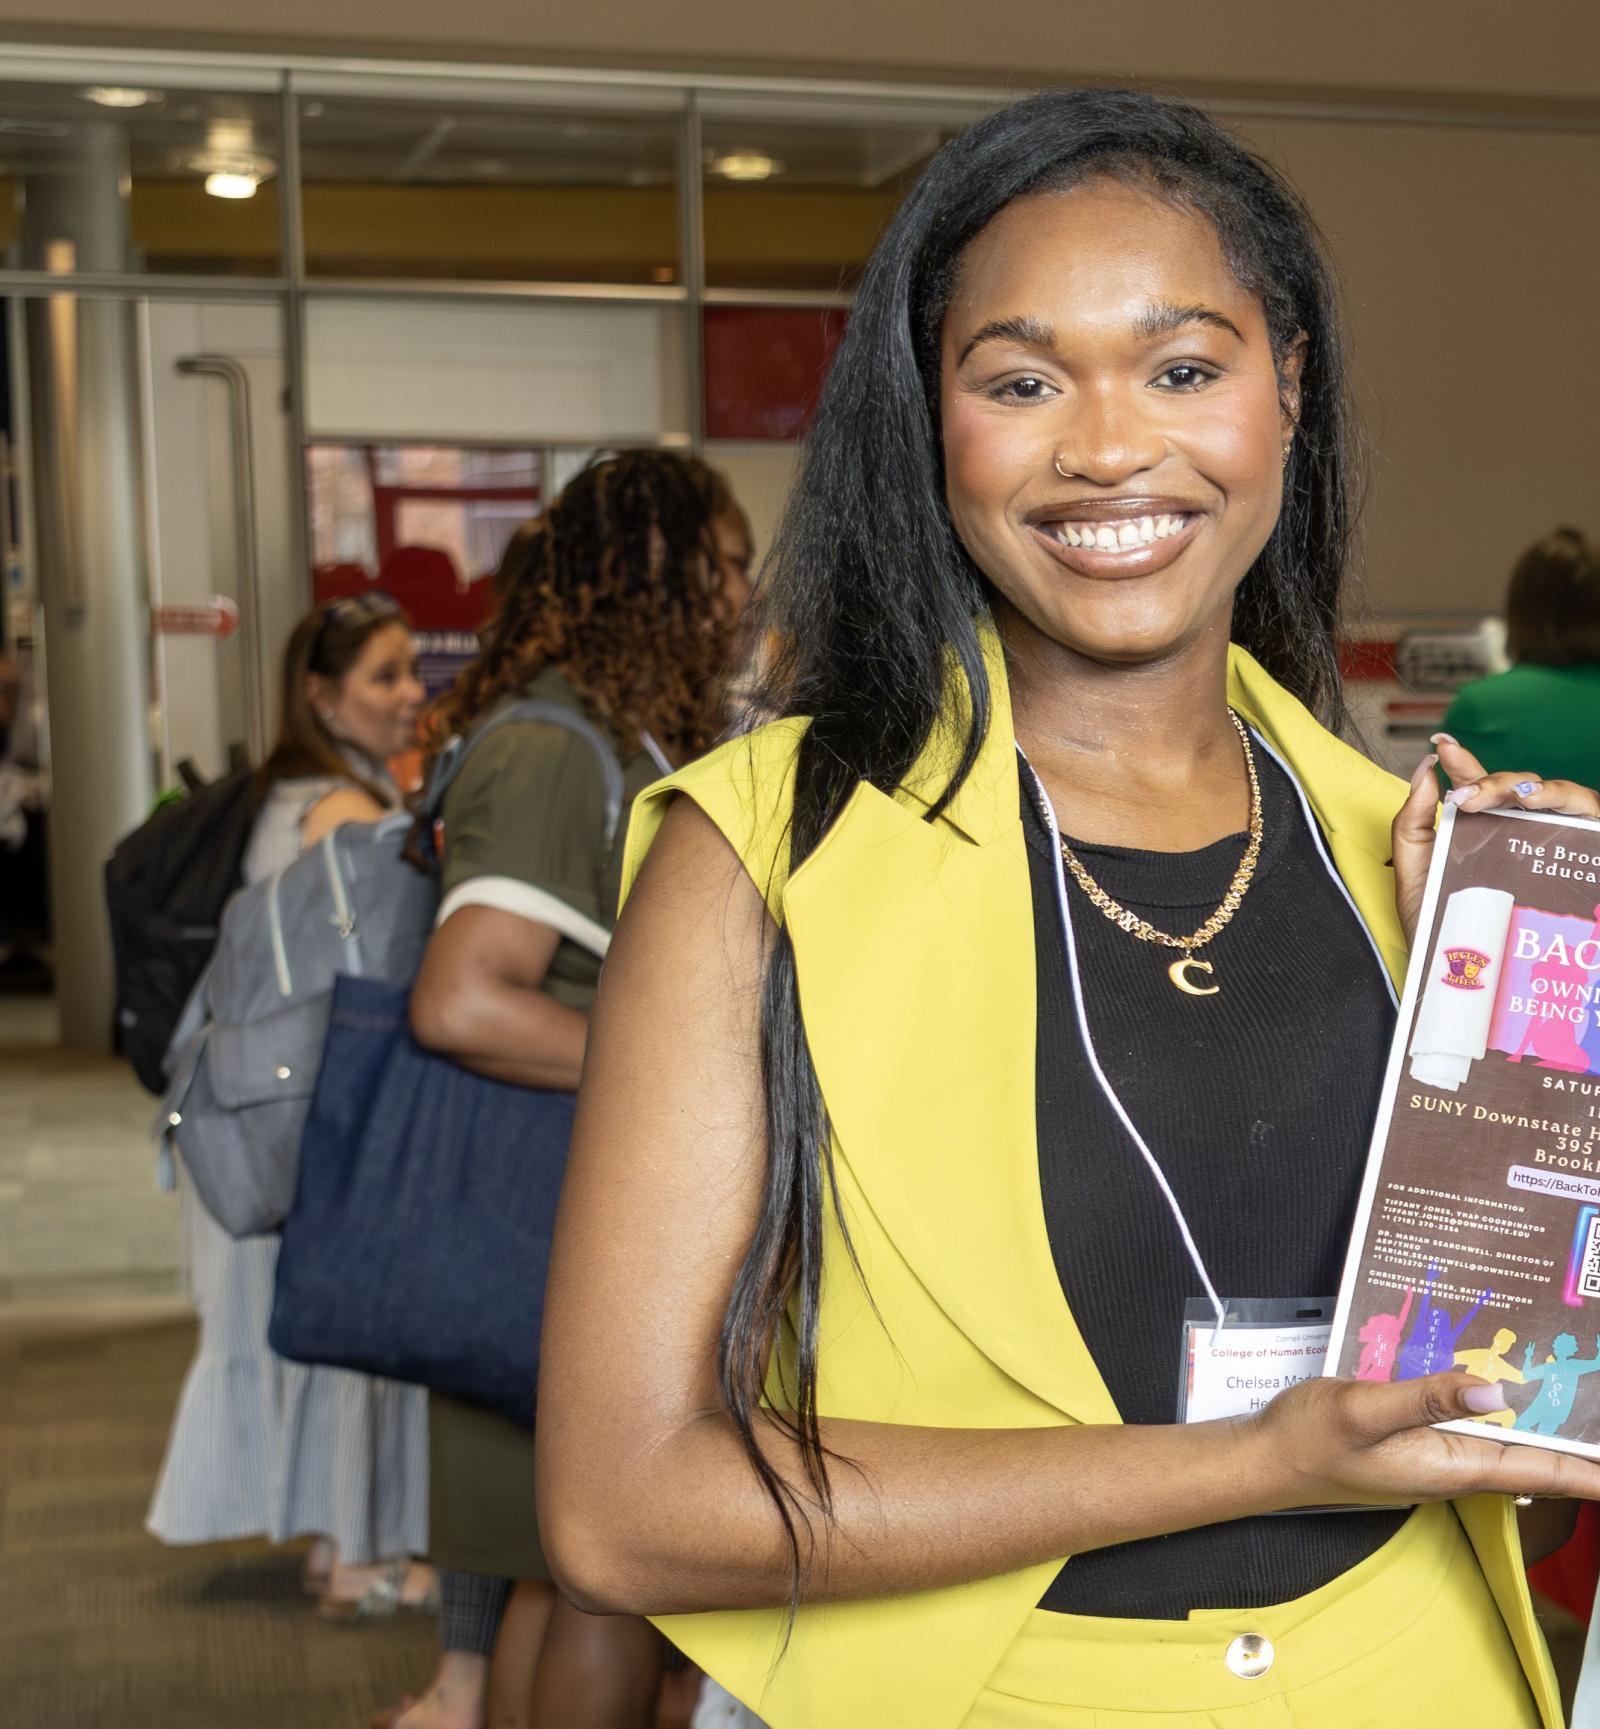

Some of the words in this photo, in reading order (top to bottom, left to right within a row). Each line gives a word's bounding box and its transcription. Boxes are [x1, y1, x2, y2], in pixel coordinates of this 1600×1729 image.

[1508, 838, 1545, 858] The
[1508, 995, 1586, 1024] BEING
[1408, 1093, 1468, 1117] SUNY
[1473, 1106, 1584, 1138] Downstate
[1555, 1136, 1595, 1155] 395
[1388, 1183, 1405, 1191] FOR
[1408, 1187, 1461, 1201] ADDITIONAL
[1464, 1197, 1525, 1212] INFORMATION
[1385, 1199, 1421, 1209] TIFFANY
[1423, 1205, 1453, 1216] JONES,
[1482, 1216, 1545, 1232] COORDINATOR
[1376, 1238, 1421, 1250] AEP/THEO
[1396, 1233, 1430, 1244] MARIAN
[1433, 1240, 1493, 1256] SEARCHWELL,
[1496, 1252, 1540, 1265] DIRECTOR
[1368, 1278, 1408, 1290] FOUNDER
[1412, 1286, 1429, 1294] AND
[1432, 1290, 1480, 1304] EXECUTIVE
[1483, 1300, 1511, 1309] CHAIR
[1369, 1270, 1416, 1284] CHRISTINE
[1419, 1279, 1457, 1292] RUCKER,
[1460, 1287, 1487, 1297] BATES
[1489, 1291, 1533, 1304] NETWORK
[1211, 1349, 1253, 1358] College
[1256, 1348, 1268, 1357] of
[1227, 1376, 1280, 1389] Chelsea
[1548, 1374, 1562, 1407] FOOD
